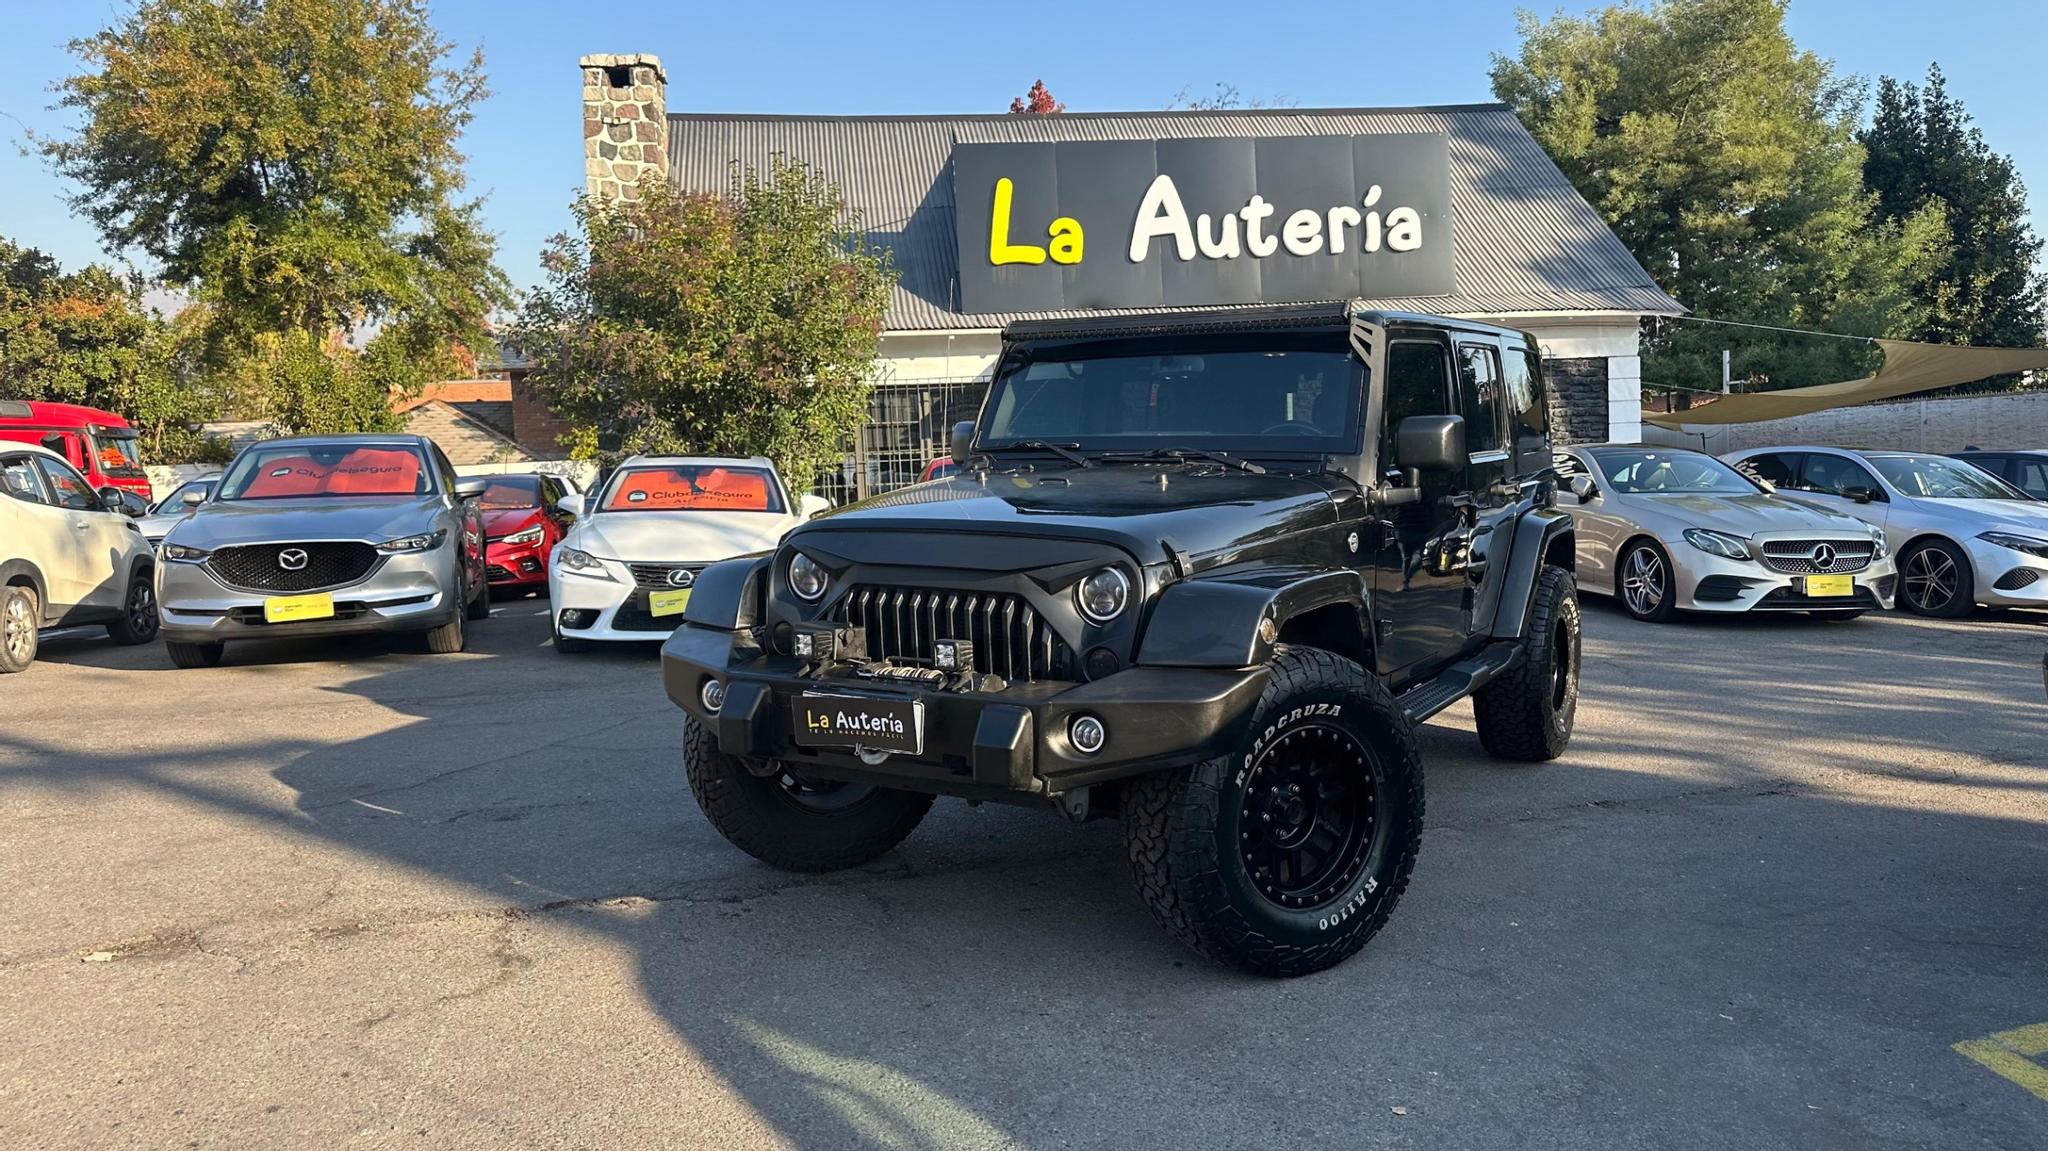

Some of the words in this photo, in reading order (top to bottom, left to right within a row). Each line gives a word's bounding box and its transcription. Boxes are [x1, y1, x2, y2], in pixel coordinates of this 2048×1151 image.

[990, 177, 1084, 266] La
[1128, 173, 1423, 264] Autería
[807, 709, 830, 729] La
[836, 711, 904, 734] Autería
